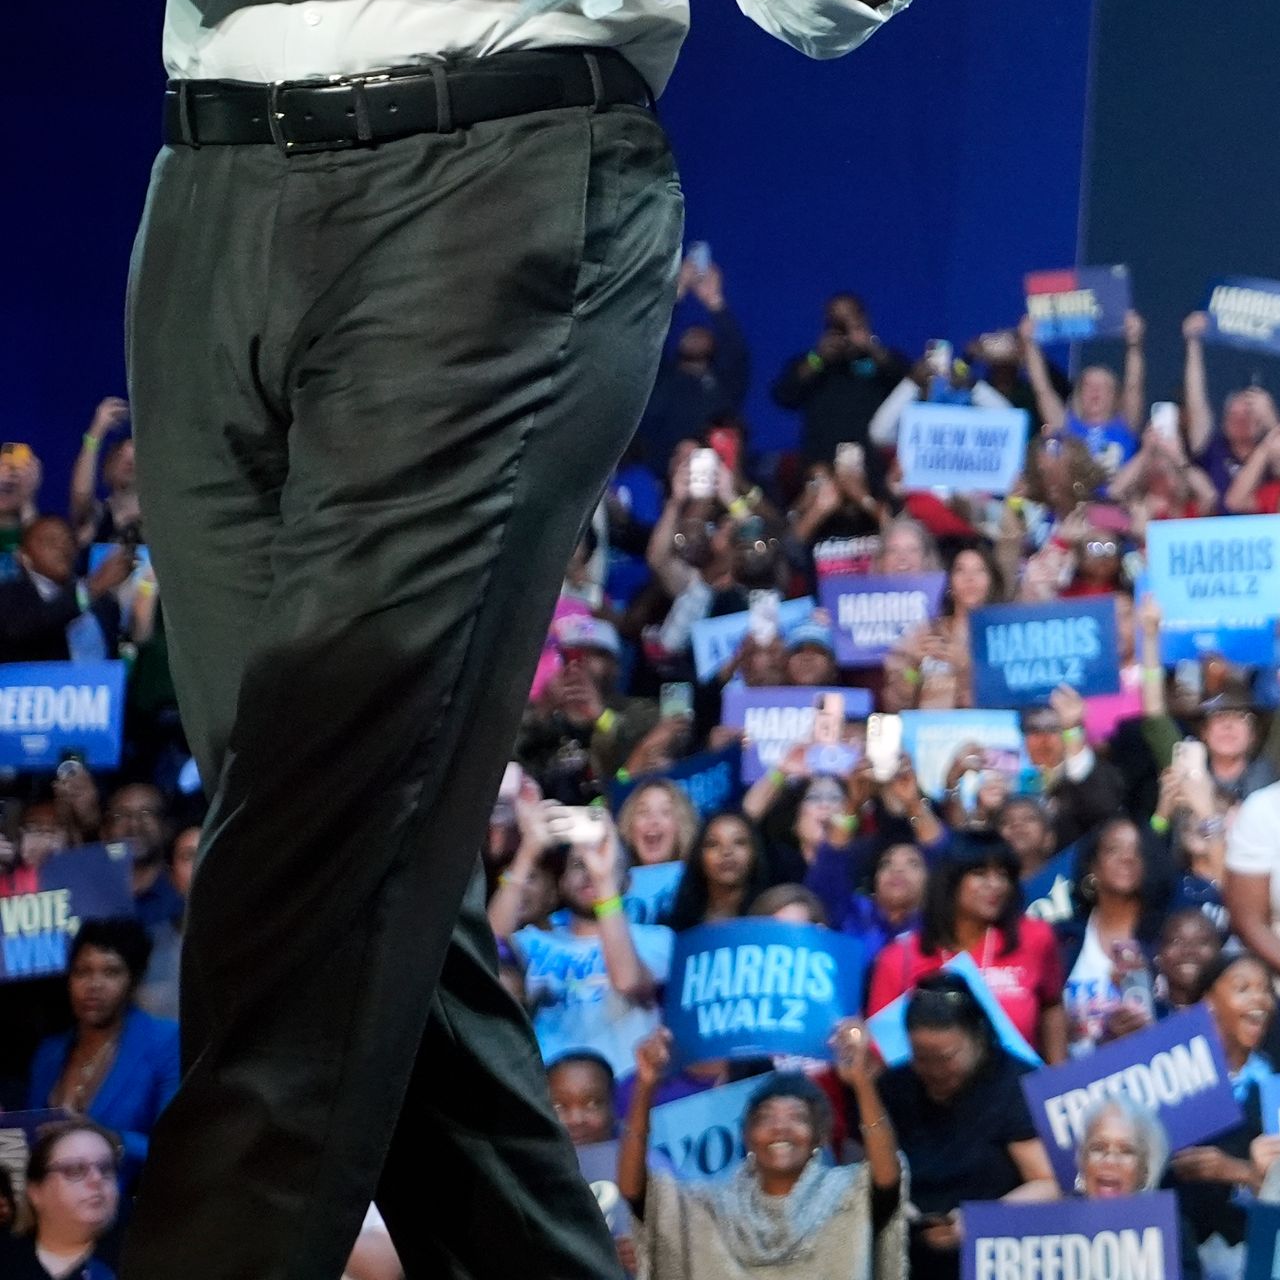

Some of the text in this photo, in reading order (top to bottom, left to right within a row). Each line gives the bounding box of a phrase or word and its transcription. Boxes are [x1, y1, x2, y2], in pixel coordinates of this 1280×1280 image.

[1217, 310, 1274, 340] WALZ
[1168, 535, 1274, 578] HARRIS
[1185, 575, 1260, 599] WALZ
[838, 590, 929, 627] HARRIS
[986, 615, 1100, 668] HARRIS
[1003, 655, 1082, 691] WALZ
[0, 684, 110, 733] EEDOM
[681, 944, 836, 1011] HARRIS
[696, 997, 809, 1039] WALZ
[975, 1226, 1165, 1280] FREEDOM
